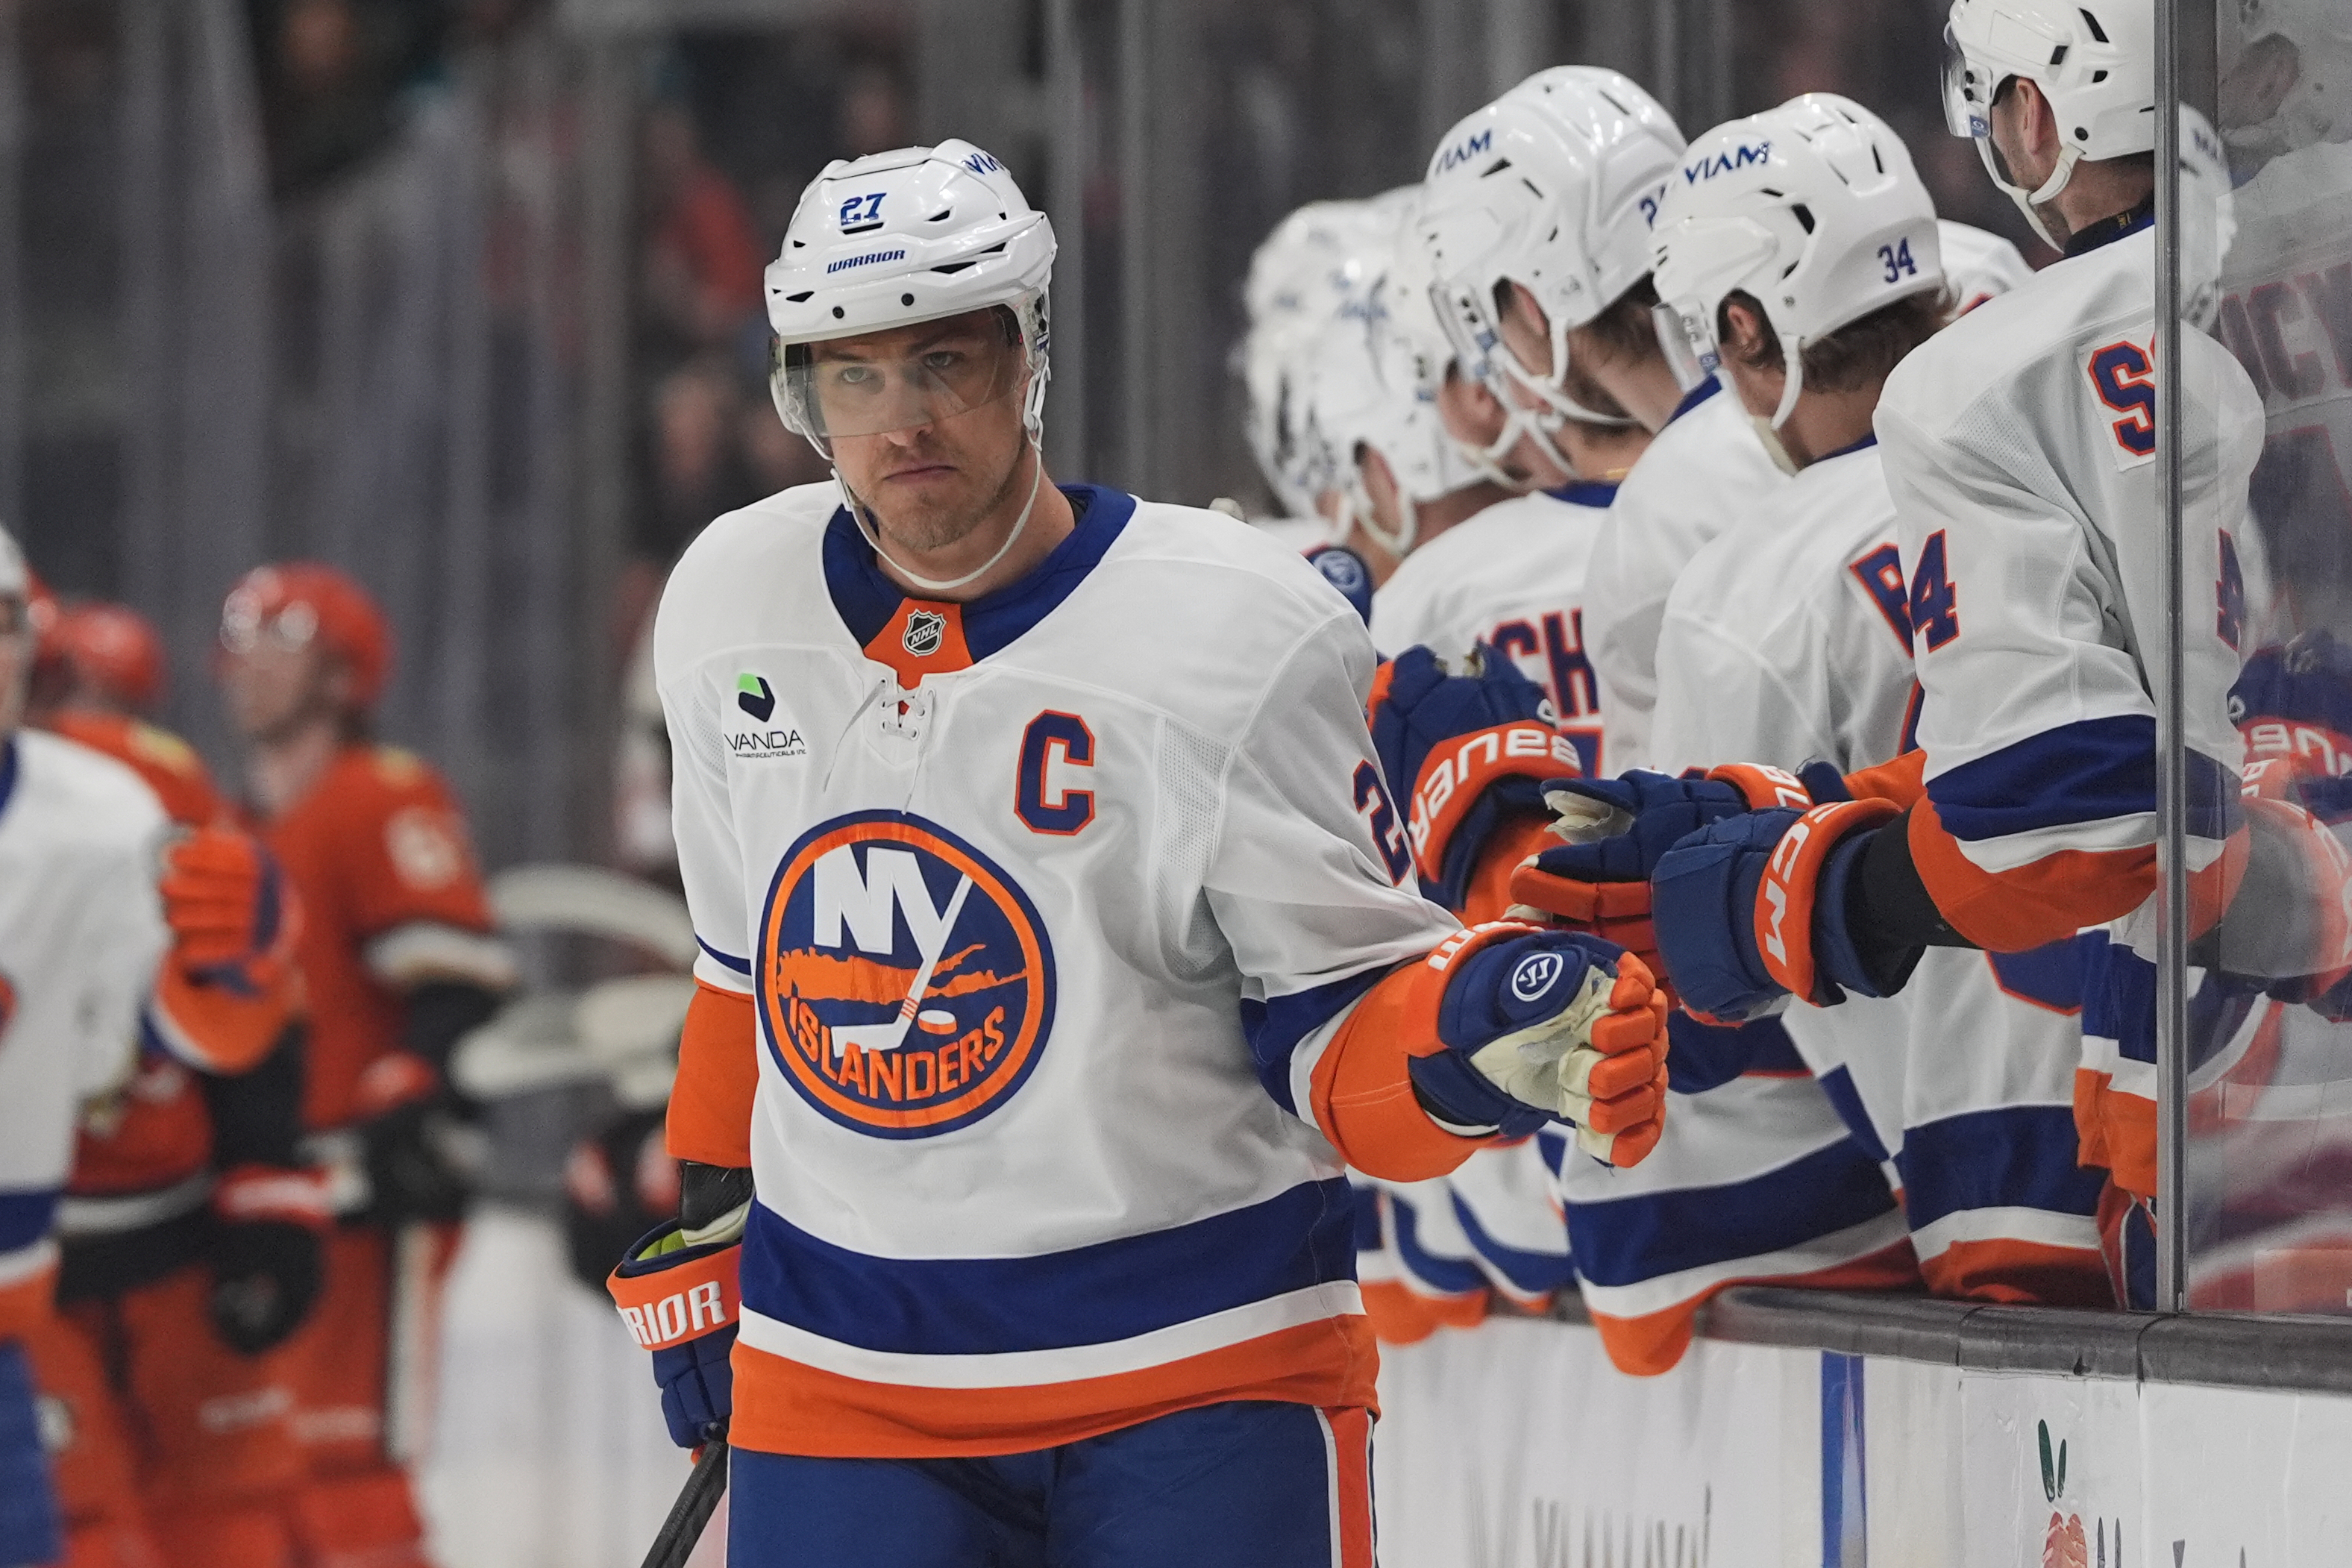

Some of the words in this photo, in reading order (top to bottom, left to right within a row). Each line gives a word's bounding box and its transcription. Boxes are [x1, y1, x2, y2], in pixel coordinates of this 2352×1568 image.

[1684, 140, 1770, 184] VIAM
[840, 192, 887, 226] 27
[827, 249, 906, 274] WARRIOR
[1877, 236, 1917, 283] 34
[911, 624, 938, 645] NHL
[724, 729, 805, 751] VANDA
[1015, 709, 1095, 835] C
[814, 844, 973, 1003] NY
[789, 997, 1005, 1102] ISLANDERS
